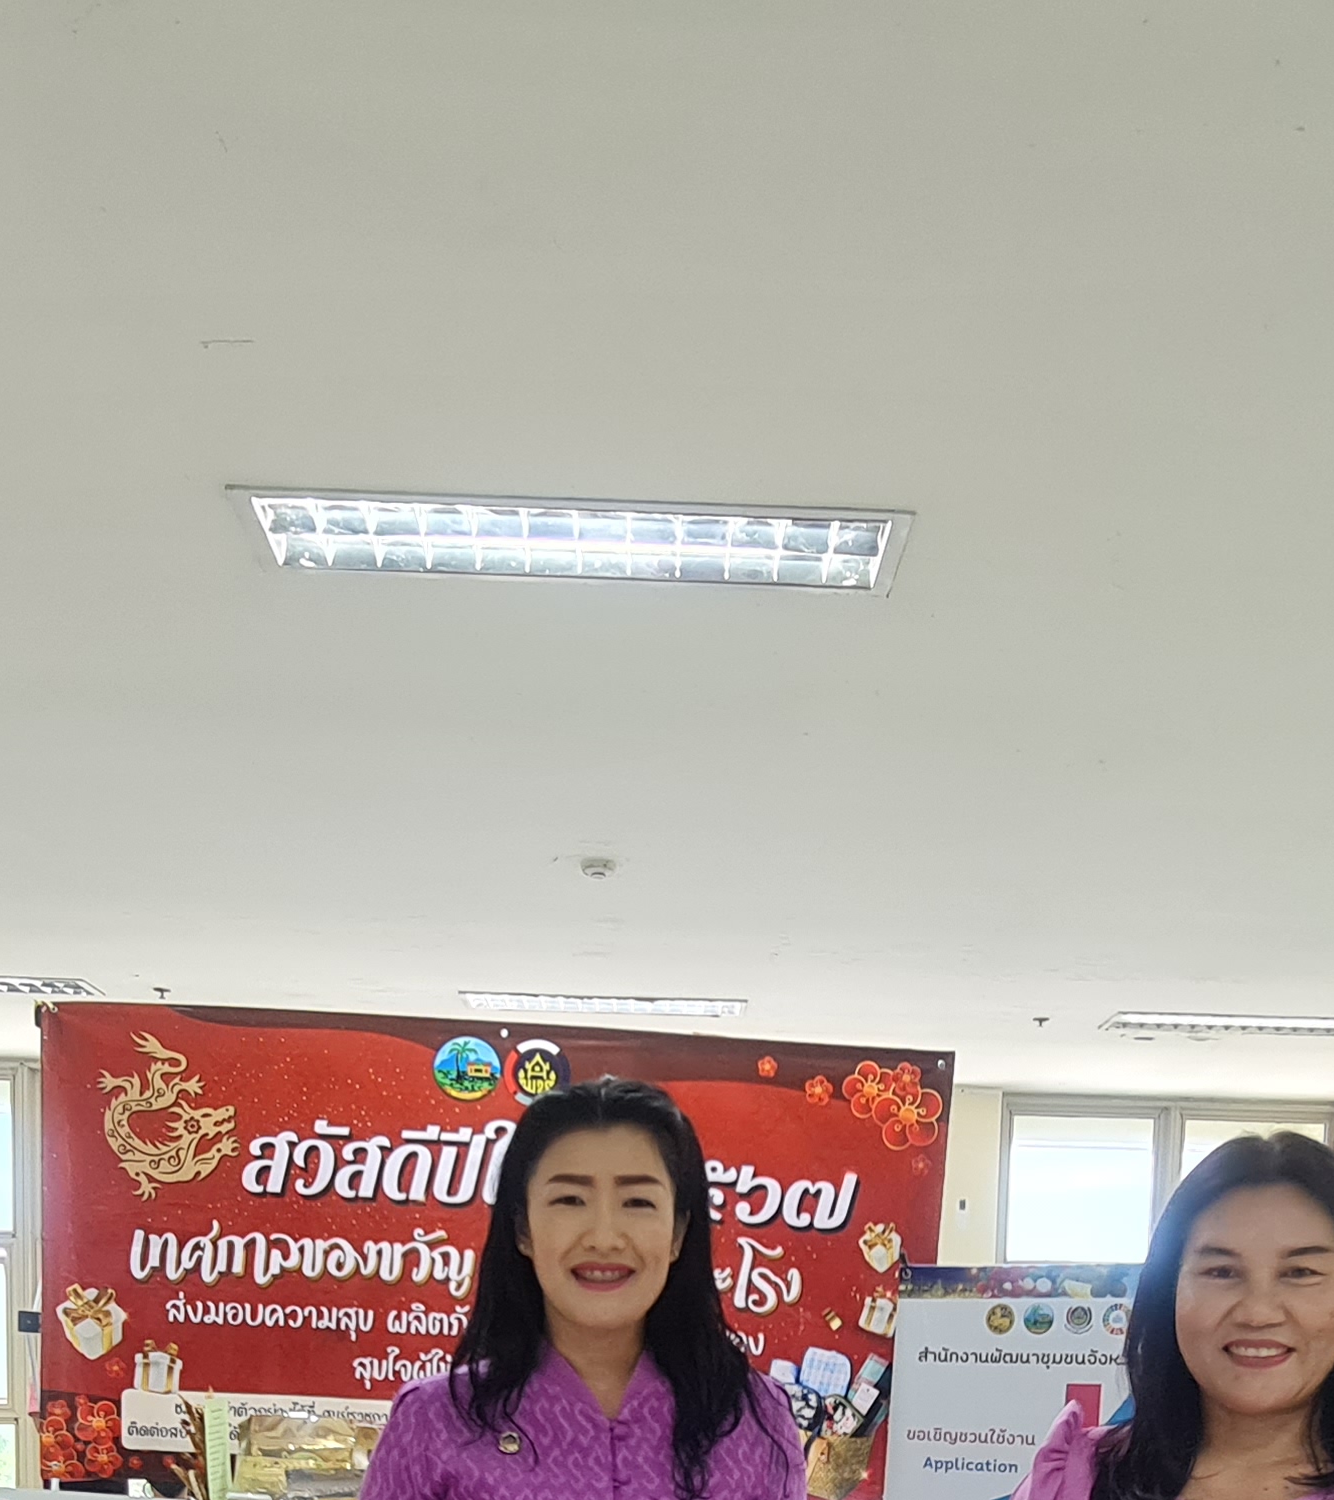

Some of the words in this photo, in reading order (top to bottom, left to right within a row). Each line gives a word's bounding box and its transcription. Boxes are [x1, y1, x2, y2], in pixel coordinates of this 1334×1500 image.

[130, 1219, 477, 1299] เทศกาลของขวัญ
[166, 1292, 374, 1342] ส่งมอบความสุข
[906, 1427, 1036, 1447] ขอเชิญชวนใช้งาน
[923, 1456, 1018, 1474] Application
